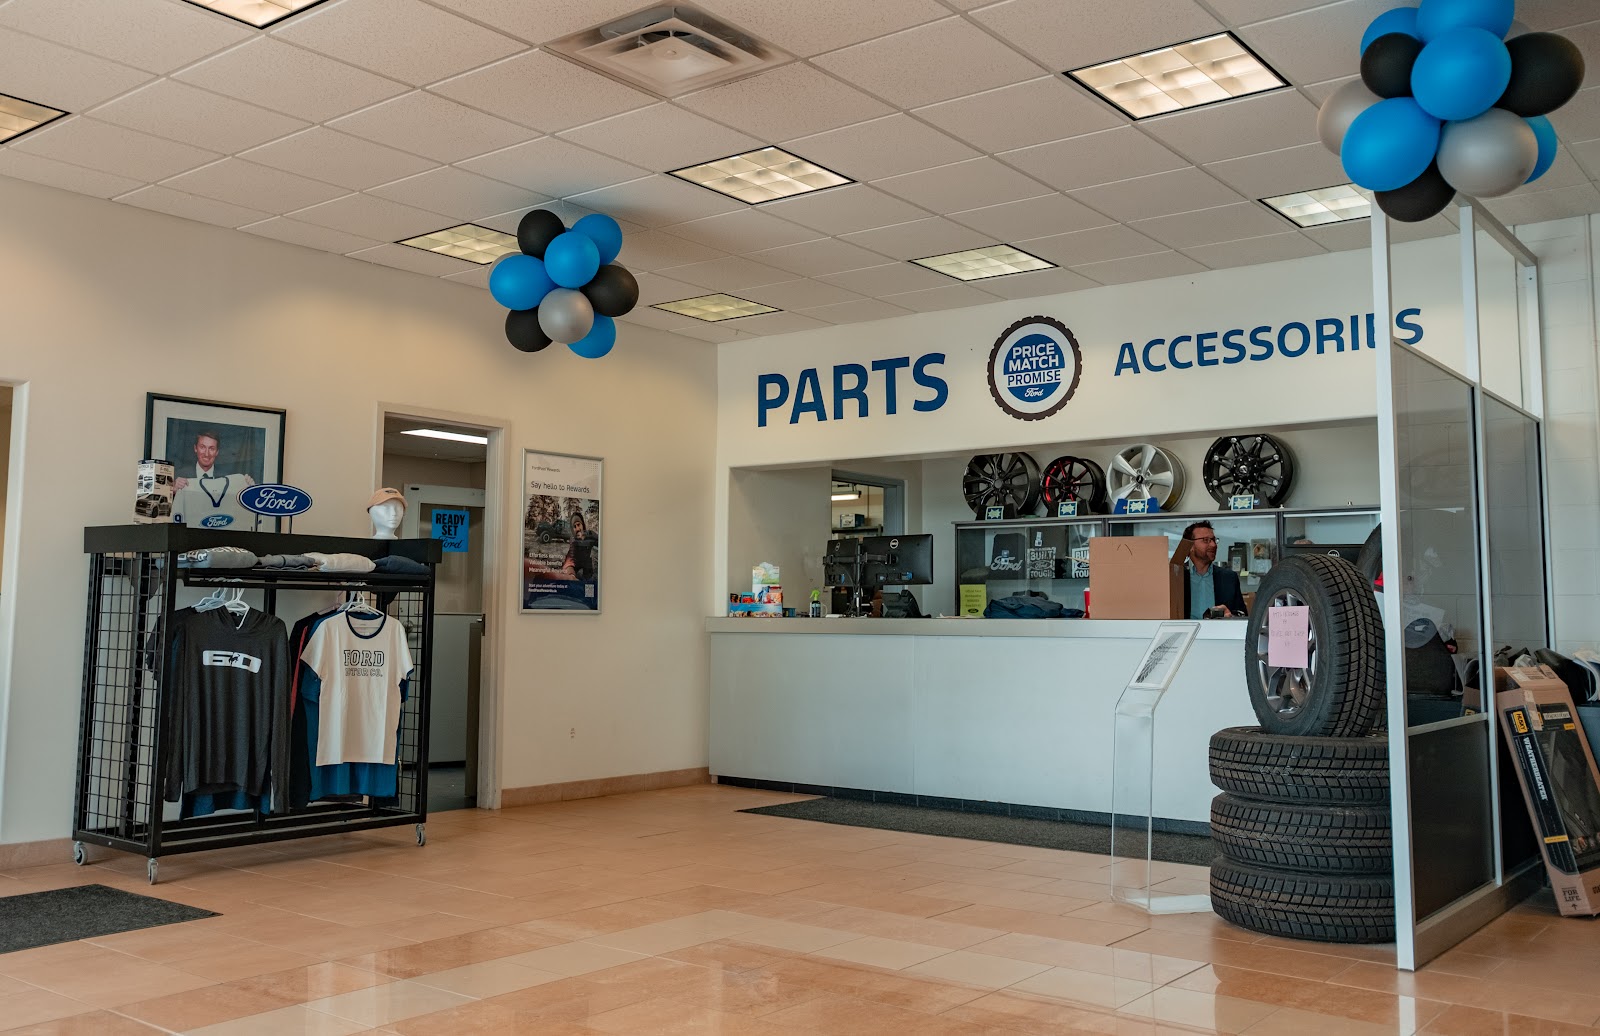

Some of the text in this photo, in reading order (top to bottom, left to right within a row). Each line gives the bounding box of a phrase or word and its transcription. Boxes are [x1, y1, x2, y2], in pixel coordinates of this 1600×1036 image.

[1012, 343, 1055, 359] PRICE
[1008, 354, 1059, 372] MATCH
[1008, 370, 1061, 386] PROMISE
[758, 353, 948, 427] PARTS
[1024, 387, 1044, 397] Ford
[530, 481, 541, 489] Say
[543, 482, 557, 490] hello
[255, 488, 298, 510] Ford
[207, 515, 229, 527] Ford
[436, 513, 465, 525] READY
[441, 525, 458, 536] SET
[1030, 550, 1054, 561] BUILT
[344, 650, 385, 667] FORD
[1516, 713, 1526, 730] HUSKY
[1523, 736, 1548, 800] WEATHERBEATER
